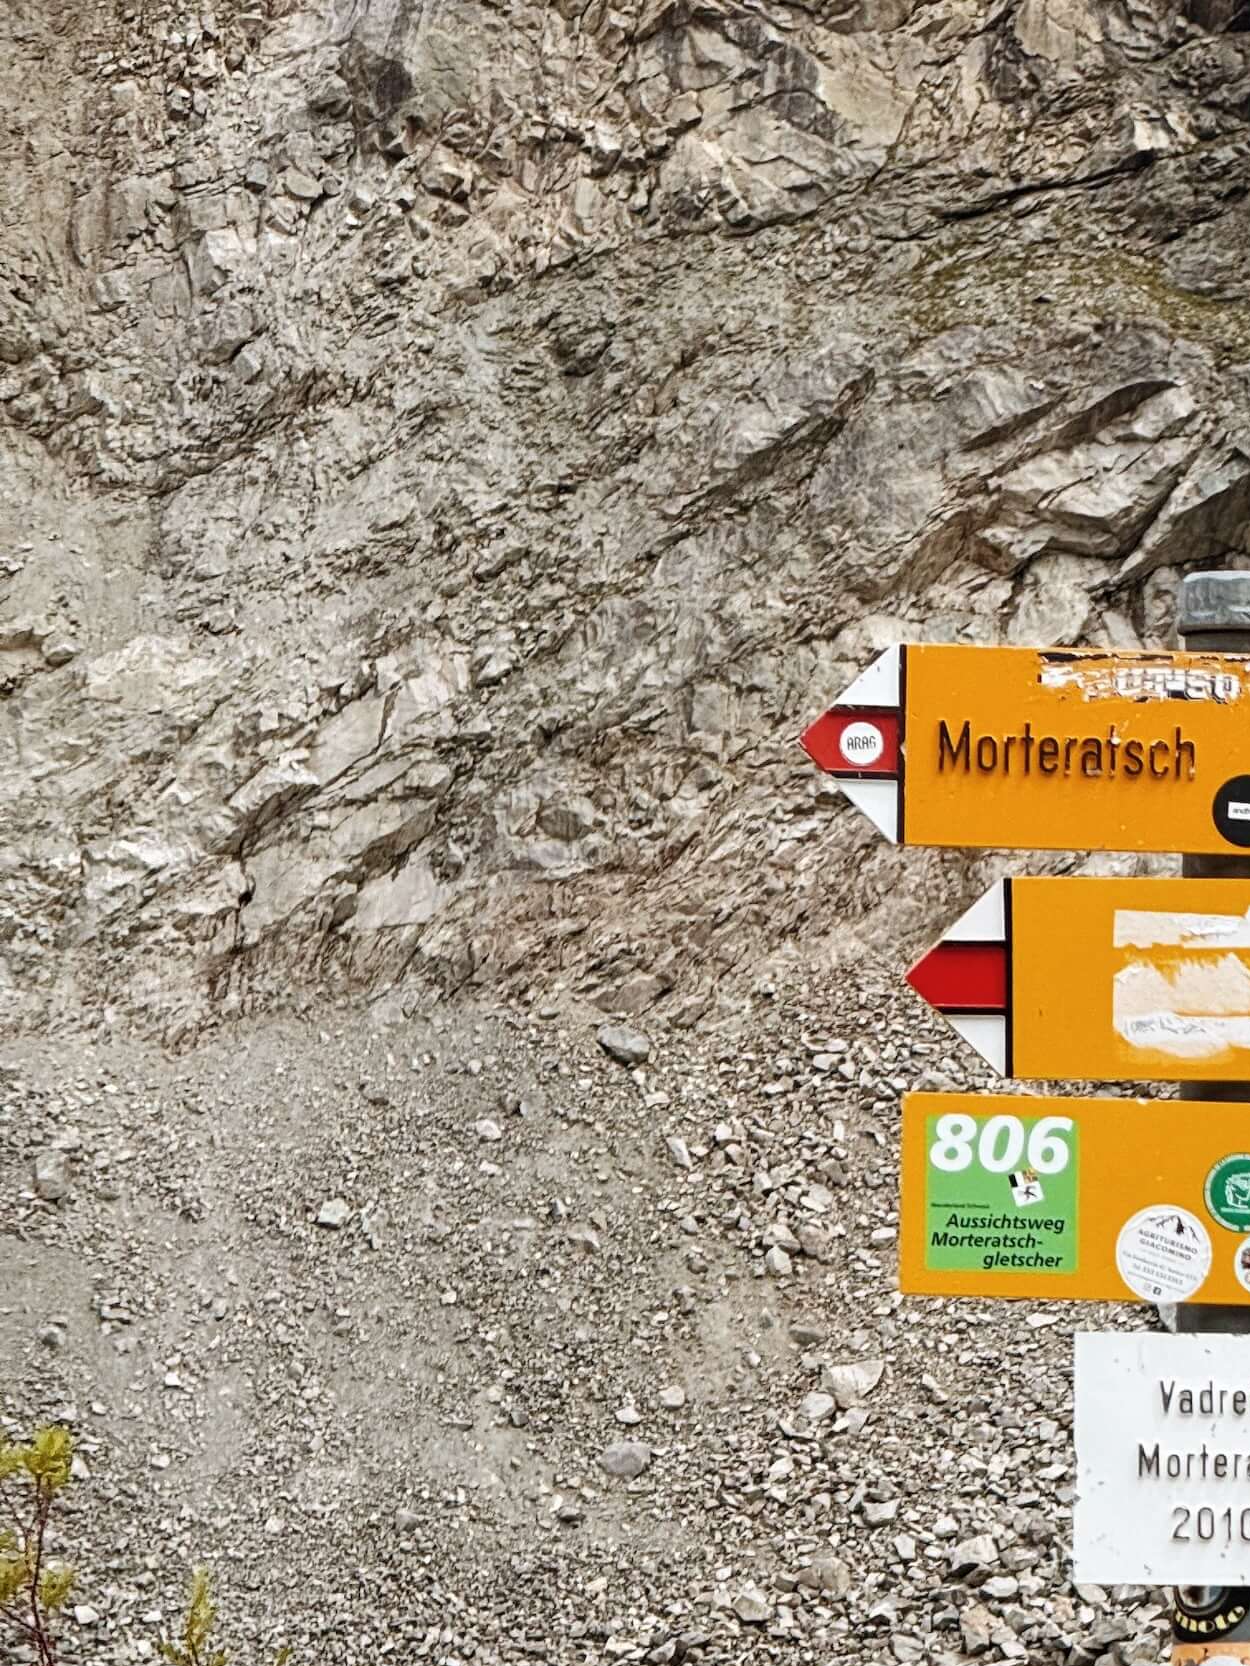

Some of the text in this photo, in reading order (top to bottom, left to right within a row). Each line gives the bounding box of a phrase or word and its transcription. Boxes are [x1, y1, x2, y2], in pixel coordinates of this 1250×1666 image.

[847, 735, 876, 750] ARAG
[938, 720, 1196, 781] Morteratsch
[929, 1113, 1073, 1174] 806
[946, 1214, 1065, 1234] Aussichtsweg
[931, 1232, 1043, 1249] Morteratsch-
[983, 1251, 1063, 1269] gletscher
